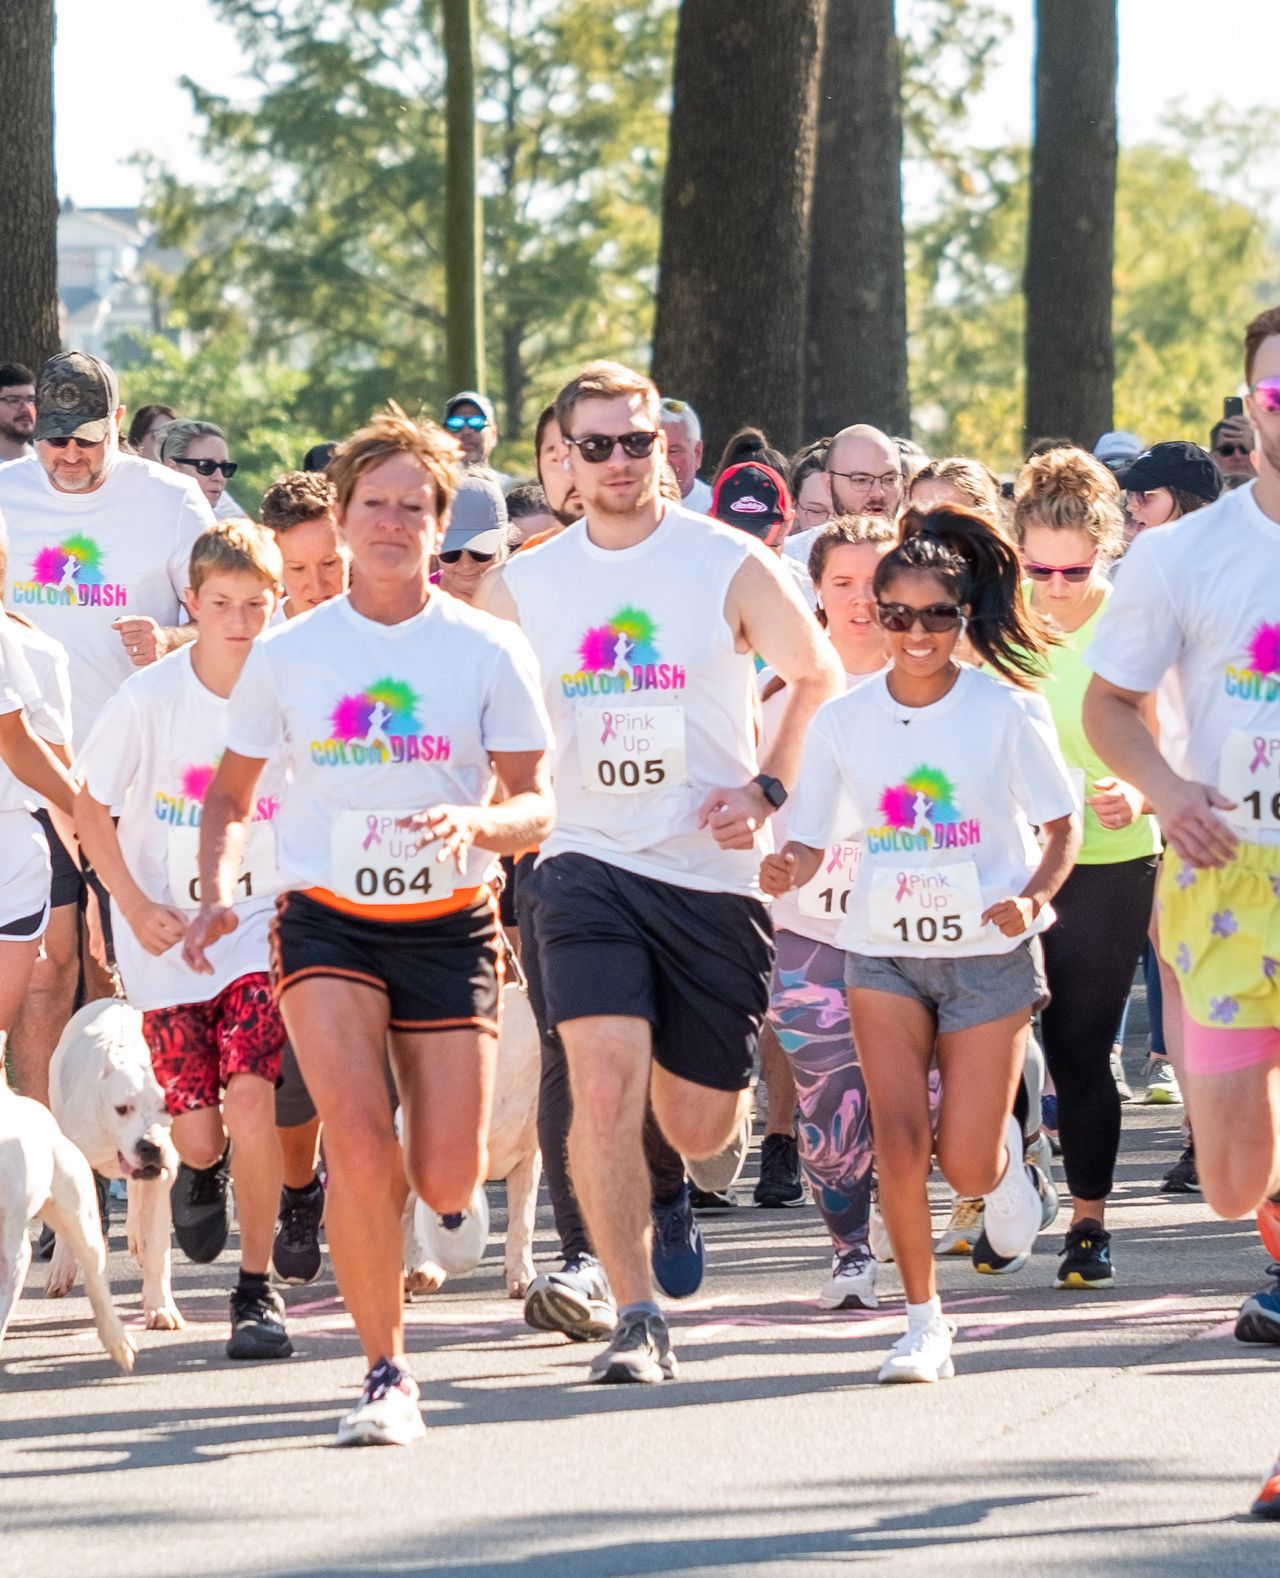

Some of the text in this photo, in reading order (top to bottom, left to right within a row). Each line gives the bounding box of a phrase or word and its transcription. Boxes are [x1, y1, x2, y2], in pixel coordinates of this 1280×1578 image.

[77, 583, 127, 606] DASH
[631, 664, 686, 692] DASH
[615, 711, 655, 730] Pink
[389, 735, 451, 764] DASH
[623, 735, 650, 755] Up
[597, 758, 665, 787] 005
[931, 818, 982, 849] DASH
[389, 839, 418, 862] Up
[355, 866, 433, 896] 064
[909, 871, 951, 889] Pink
[919, 892, 948, 912] Up
[893, 914, 963, 942] 105
